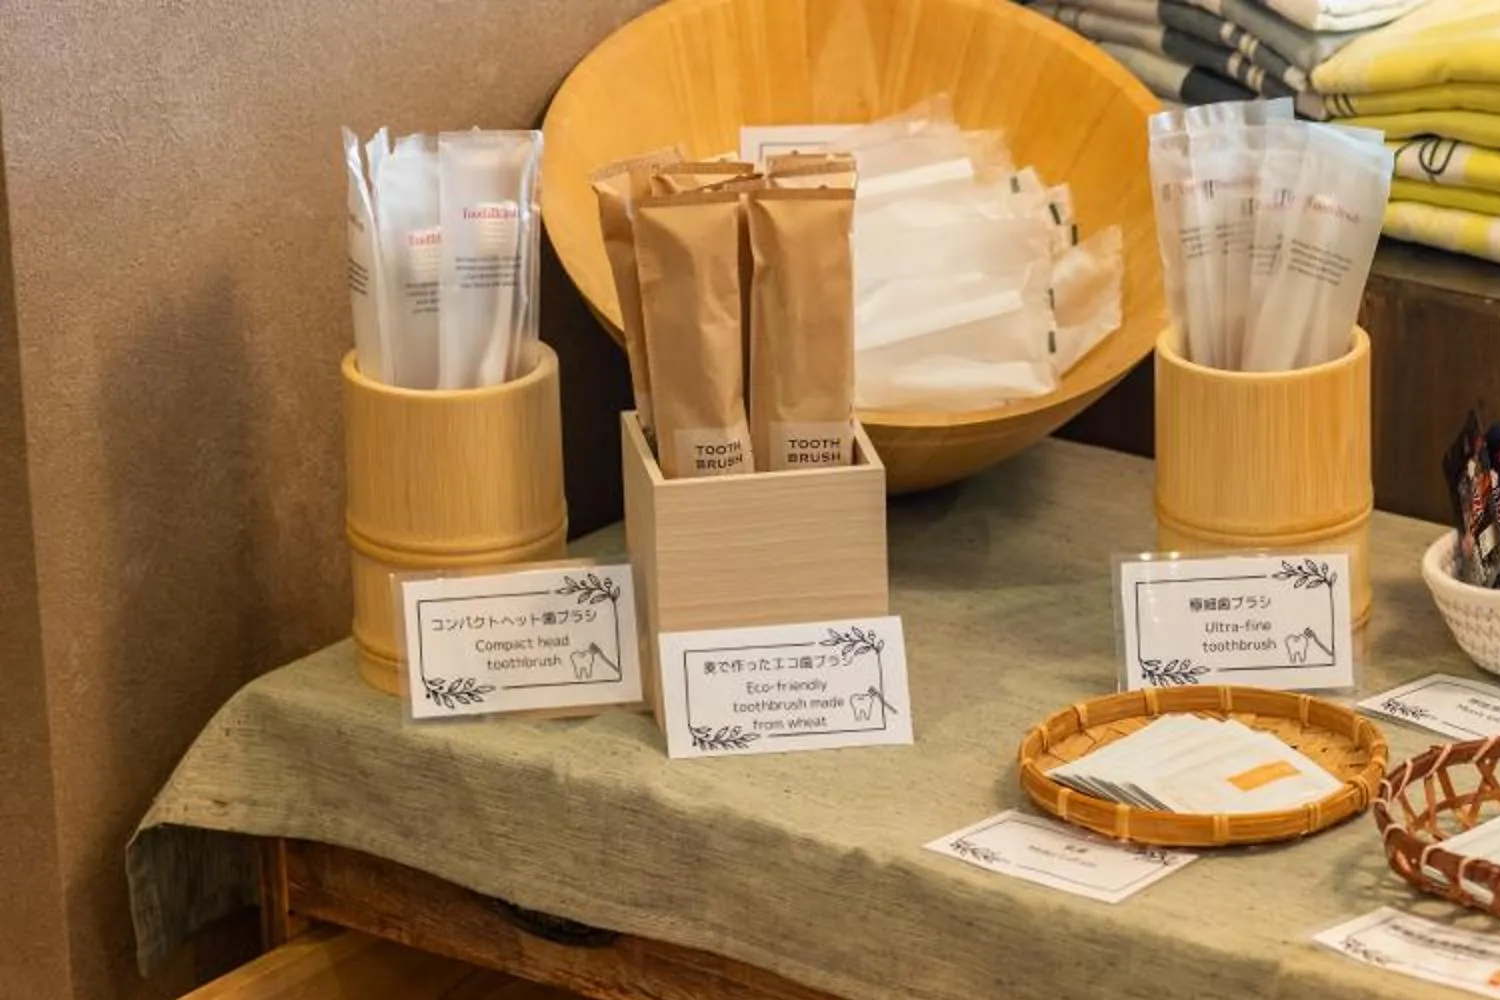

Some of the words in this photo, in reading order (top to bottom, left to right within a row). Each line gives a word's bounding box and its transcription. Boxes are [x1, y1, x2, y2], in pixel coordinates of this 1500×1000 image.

[695, 440, 741, 456] TOOTH
[788, 438, 841, 450] TOOTH
[695, 455, 743, 470] BRUSH
[787, 451, 841, 464] BRUSH
[1204, 619, 1273, 634] Ultra-fine
[475, 638, 533, 653] Compact
[538, 635, 570, 647] head
[1202, 639, 1277, 654] toothbrush
[487, 654, 562, 671] toothbrush
[746, 679, 827, 695] Eco-friendly
[733, 698, 807, 713] toothbrush
[810, 696, 845, 708] made
[753, 719, 784, 731] from
[787, 716, 827, 730] wheat
